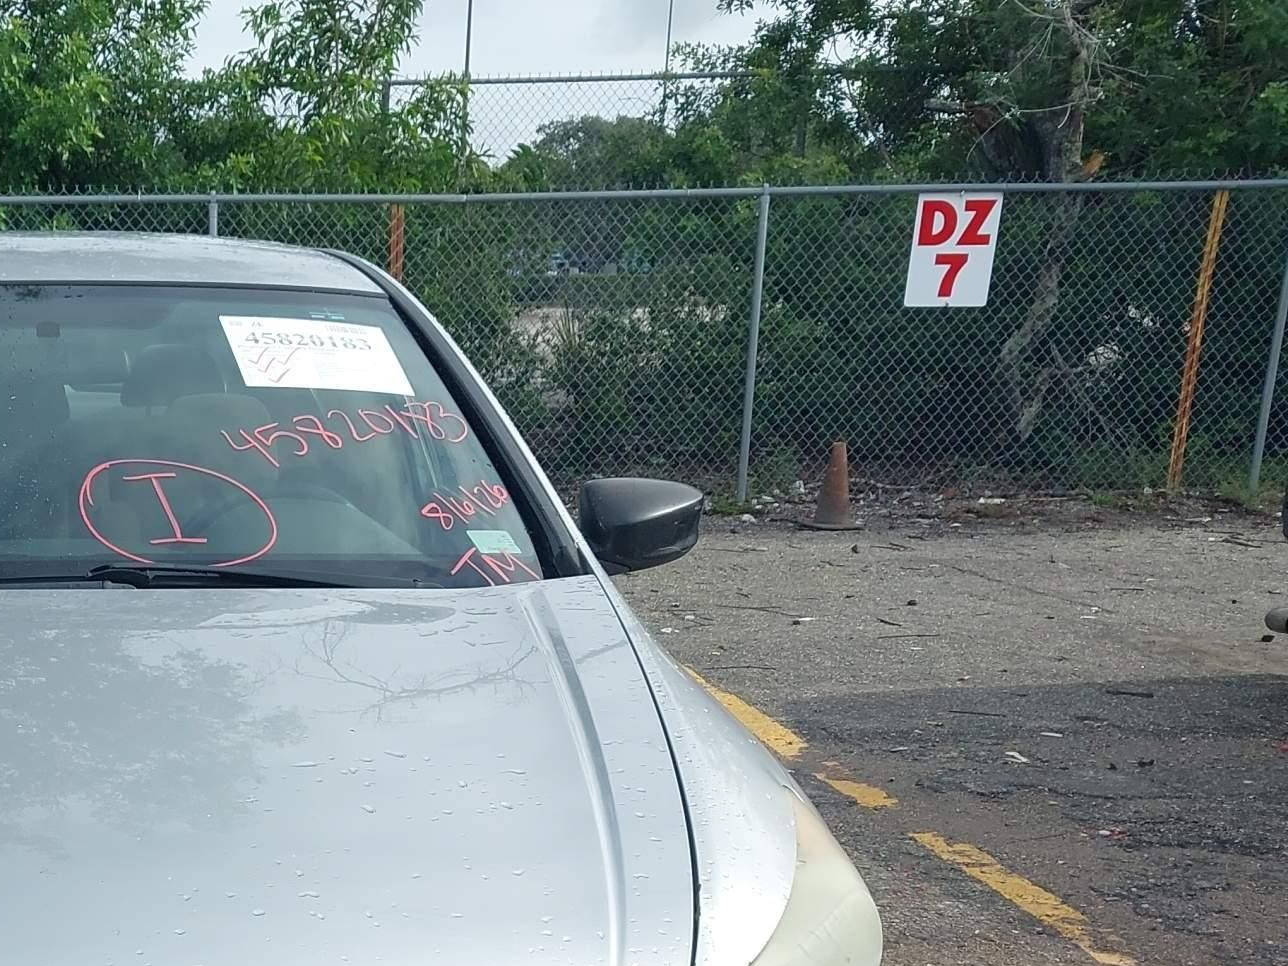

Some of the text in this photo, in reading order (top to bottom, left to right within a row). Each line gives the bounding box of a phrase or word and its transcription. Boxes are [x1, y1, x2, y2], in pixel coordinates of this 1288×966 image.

[918, 199, 998, 246] DZ
[934, 253, 969, 297] 7
[244, 331, 373, 351] 45820183
[220, 400, 469, 468] 45820183
[420, 479, 510, 531] 8/6/26
